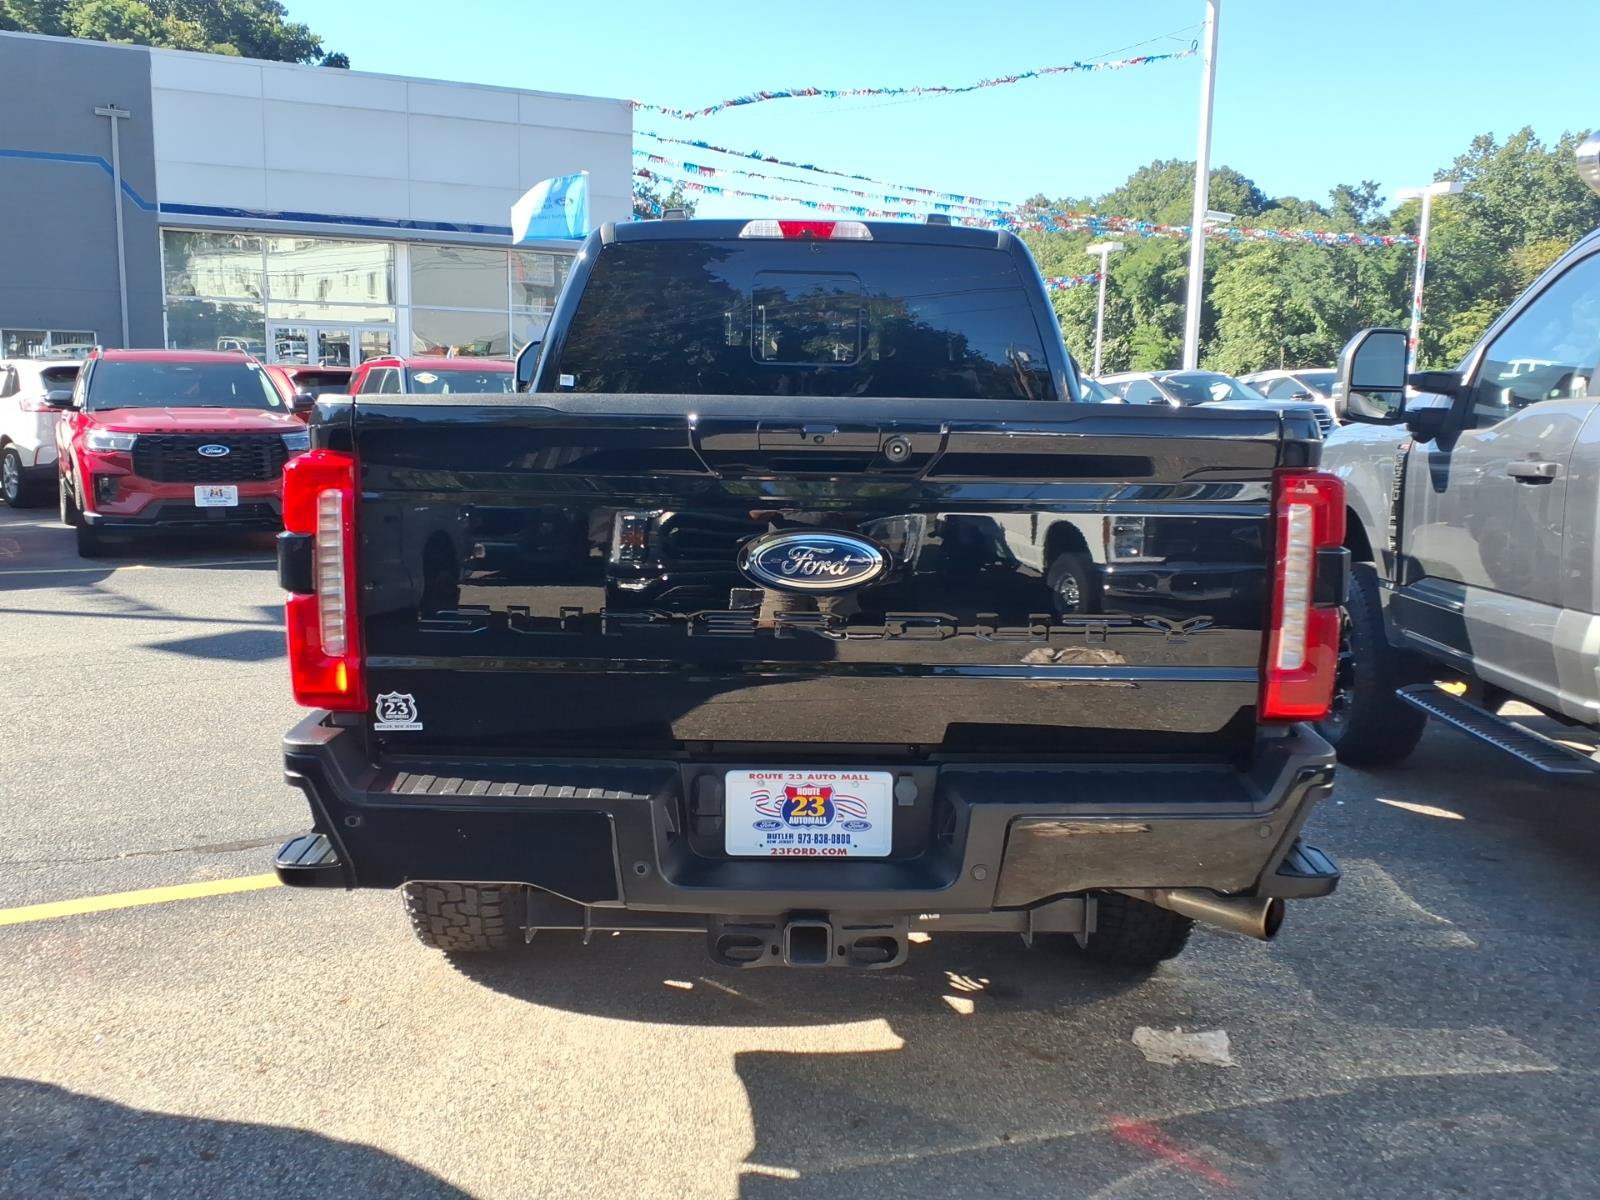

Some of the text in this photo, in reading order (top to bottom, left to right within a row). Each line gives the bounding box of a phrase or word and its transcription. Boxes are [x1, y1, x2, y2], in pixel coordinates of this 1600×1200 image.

[781, 546, 851, 576] Ford
[417, 604, 1215, 644] SUPER DUTY
[384, 702, 409, 715] 23
[796, 787, 821, 796] ROUTE
[790, 796, 826, 817] 23
[760, 820, 777, 828] Ford
[788, 816, 828, 825] AUTOMALL
[848, 820, 865, 828] Ford
[797, 833, 851, 845] 973-838-0800
[770, 847, 848, 855] 23FORD.COM
